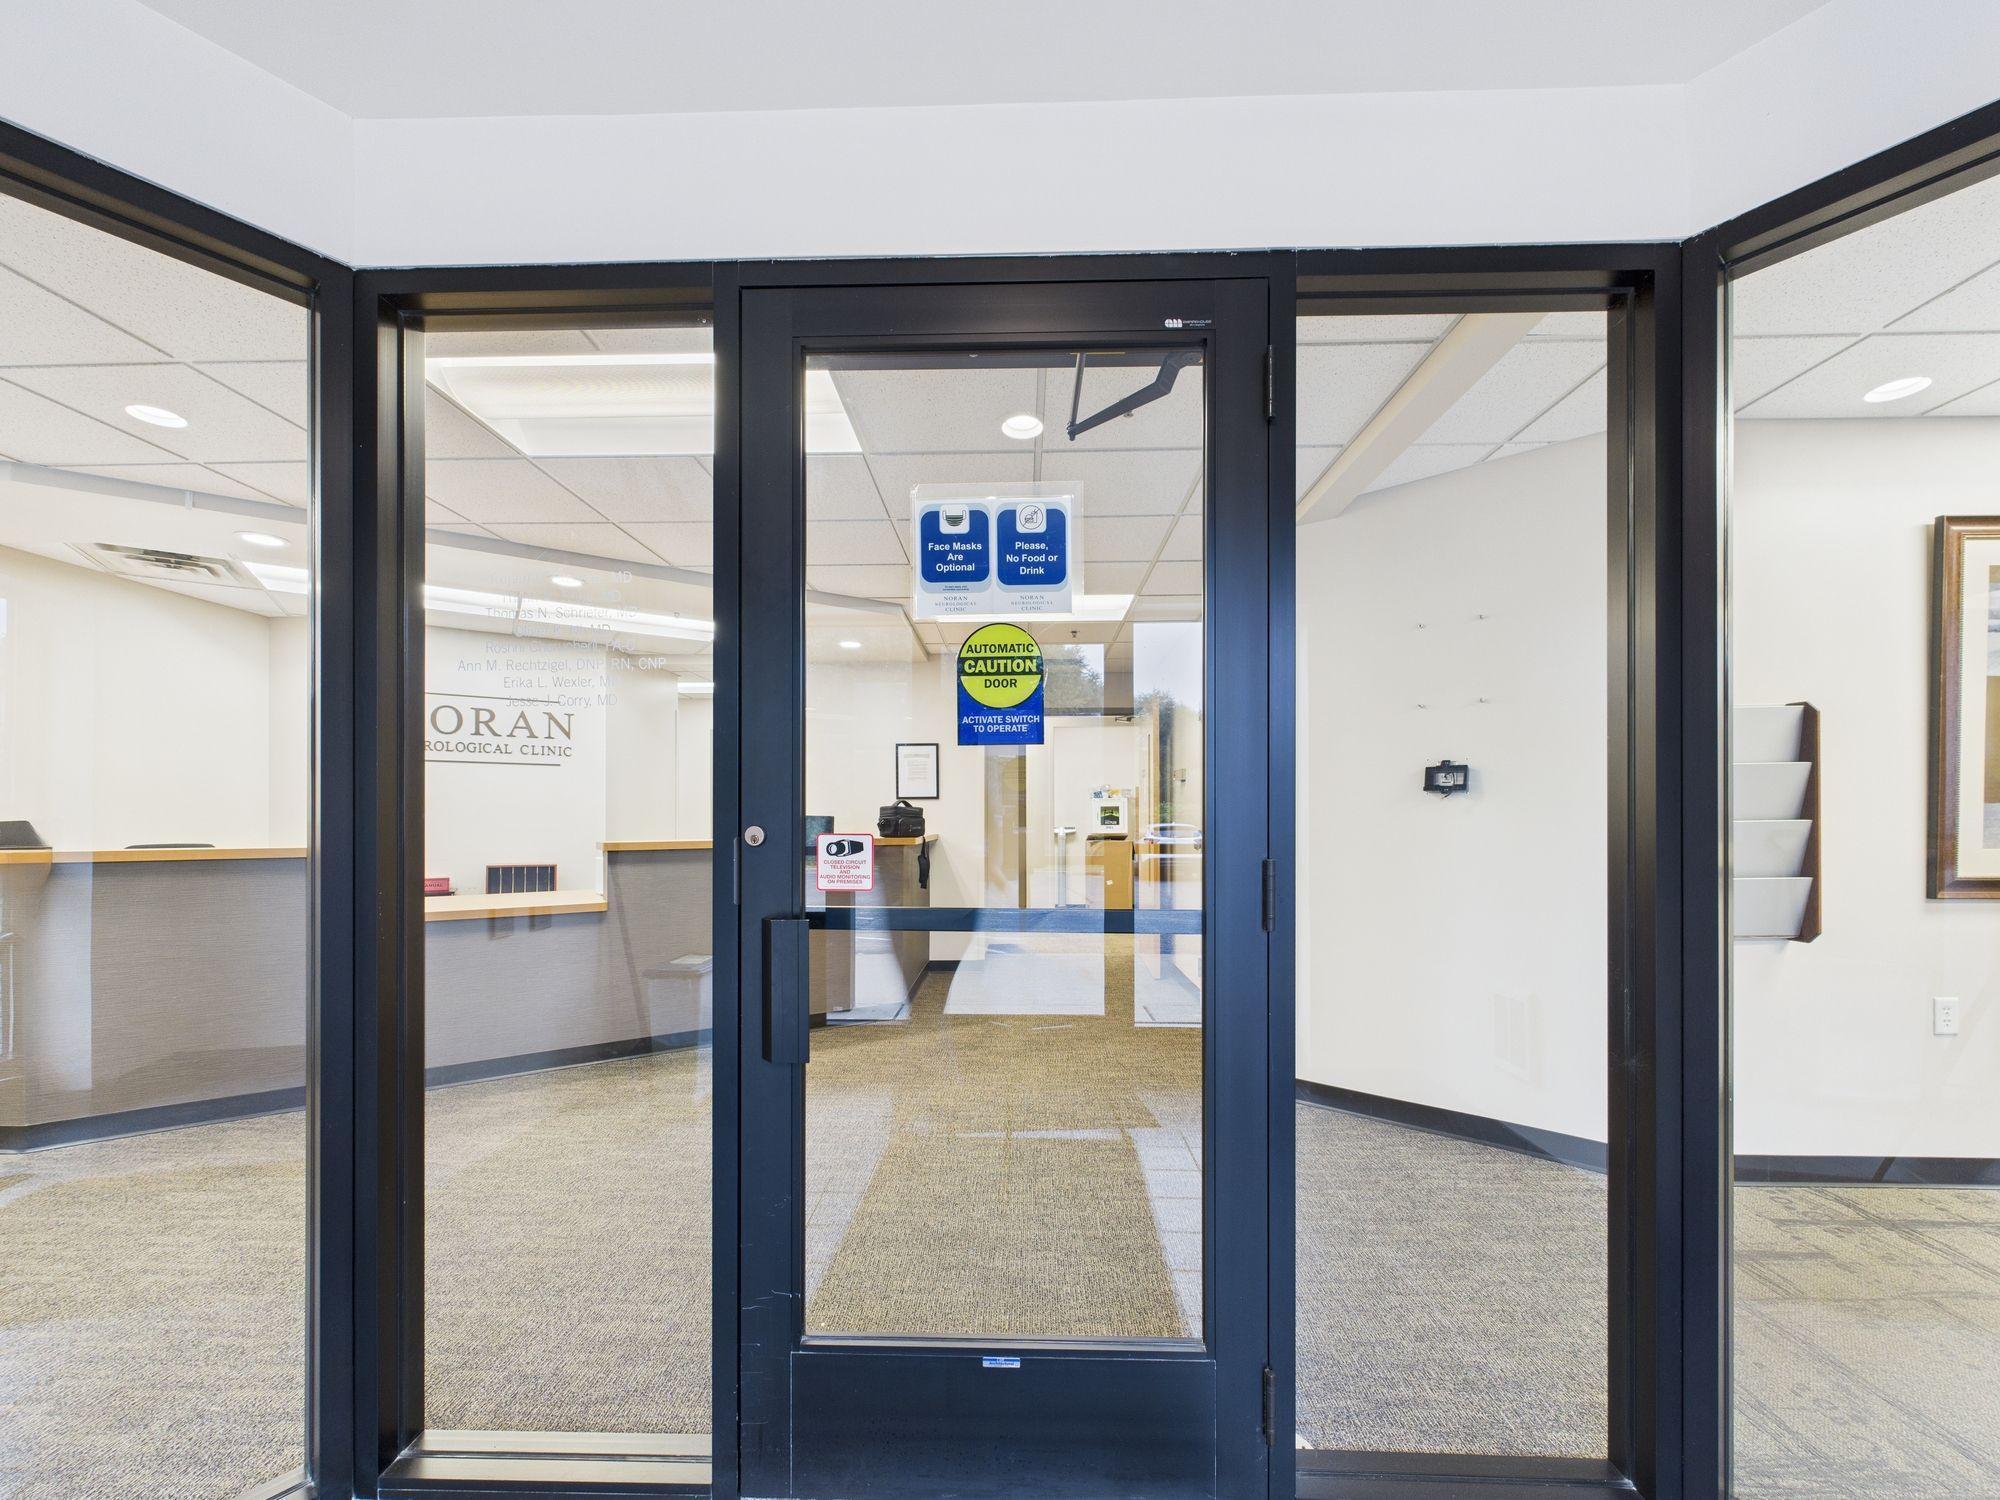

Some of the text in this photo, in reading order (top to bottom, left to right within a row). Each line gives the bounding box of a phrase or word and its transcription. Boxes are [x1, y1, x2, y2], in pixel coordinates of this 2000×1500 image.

[928, 542, 982, 551] Face Masks
[1015, 541, 1049, 551] Please,
[946, 552, 964, 561] Are
[1006, 554, 1020, 563] No
[1021, 553, 1046, 562] Food
[935, 563, 975, 573] Optional
[1019, 566, 1045, 575] Drink
[966, 643, 1034, 654] AUTOMATIC
[457, 659, 482, 672] Ann
[638, 657, 667, 670] CNP
[963, 658, 1037, 673] CAUTION
[503, 676, 534, 689] Erika
[984, 679, 1018, 688] DOOR
[557, 694, 592, 708] Corry,
[430, 705, 575, 741] ORAN
[962, 715, 1040, 724] ACTIVATE SWITCH
[973, 724, 1028, 733] TO OPERATE
[425, 740, 572, 757] ROLOGICAL CLINIC
